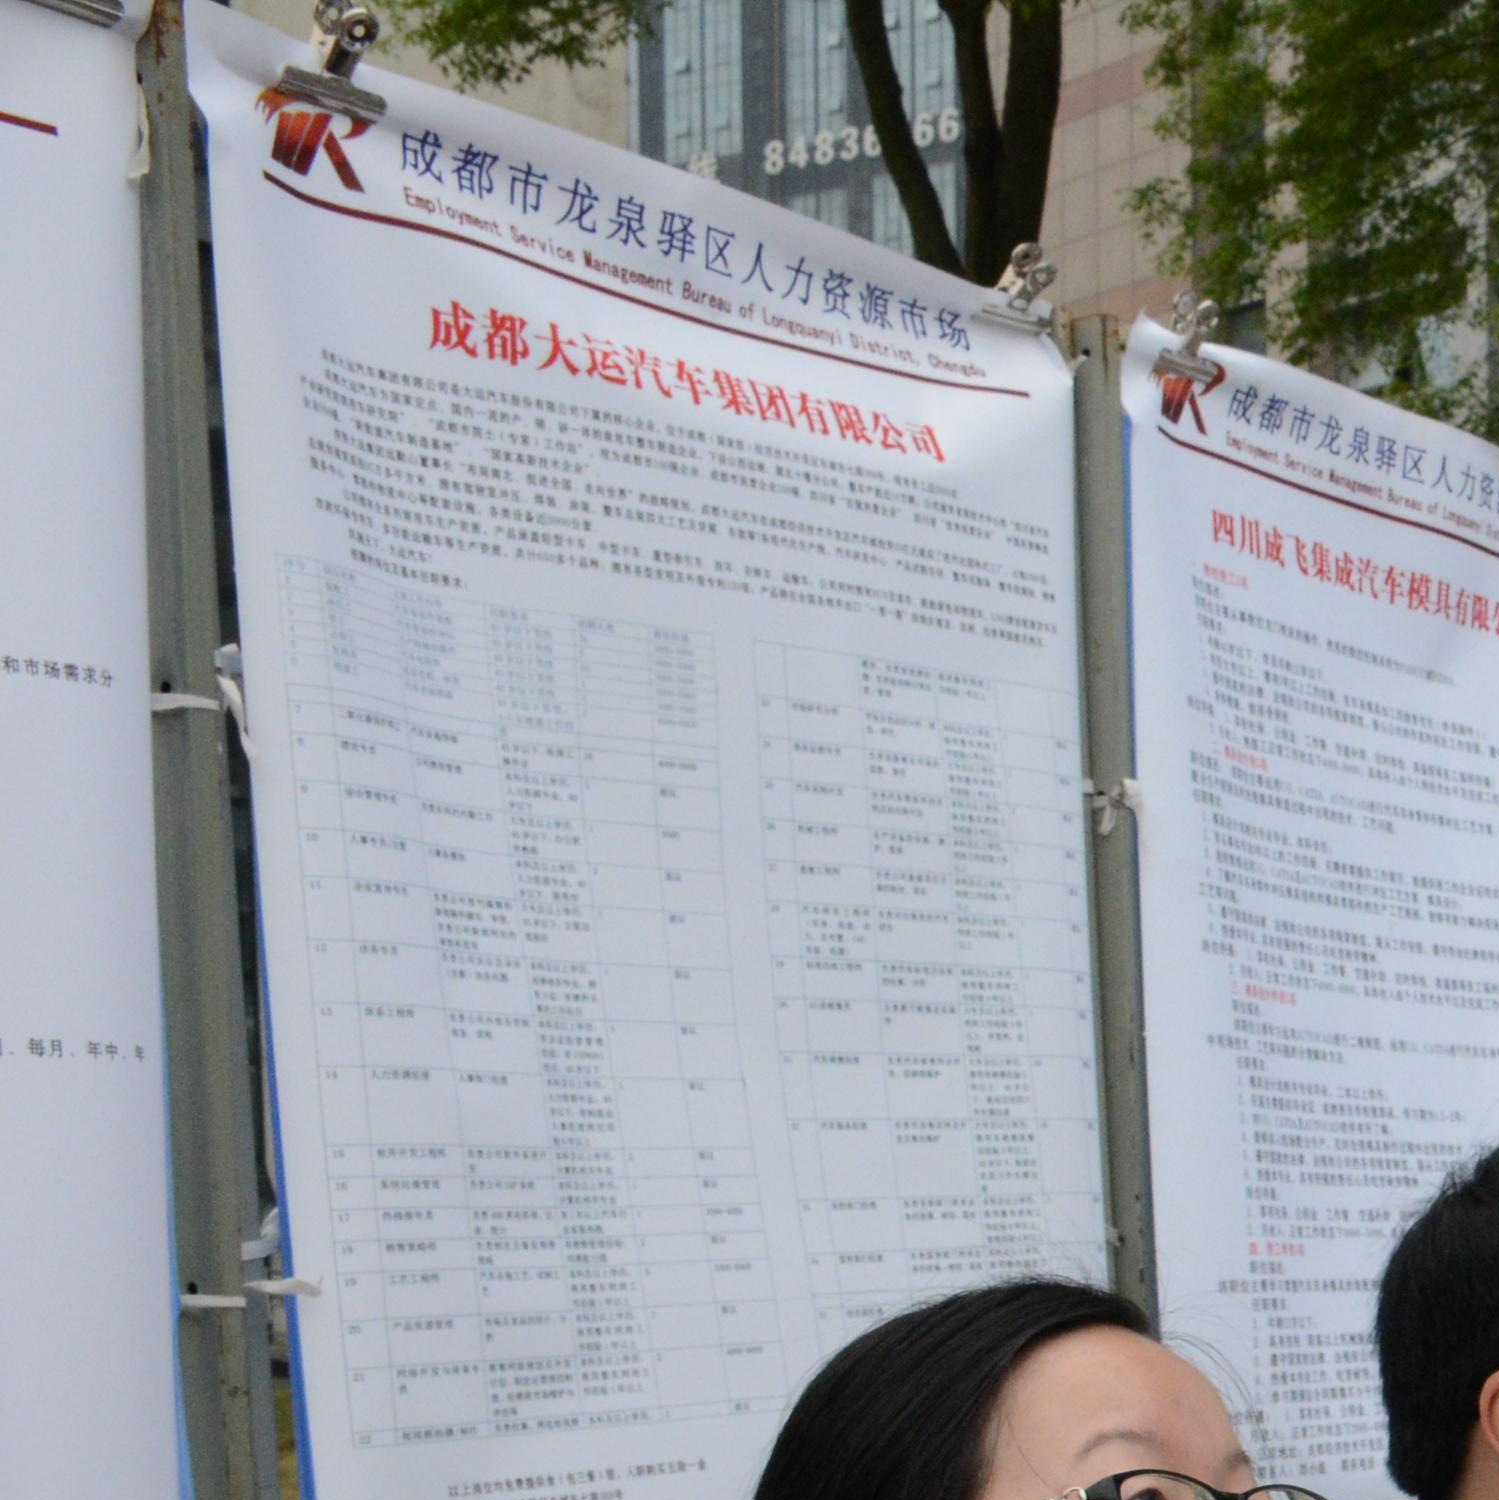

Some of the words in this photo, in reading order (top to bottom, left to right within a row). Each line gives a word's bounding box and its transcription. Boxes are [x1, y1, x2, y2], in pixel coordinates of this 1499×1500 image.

[763, 108, 960, 176] 8483666
[401, 129, 971, 352] 成都市龙泉驿区人力资源市场
[404, 186, 503, 238] Employment
[510, 224, 575, 264] Service
[582, 249, 674, 297] Management
[682, 281, 732, 315] Bureau
[739, 303, 756, 324] of
[762, 308, 844, 348] Longquanyi
[850, 331, 921, 366] District,
[928, 351, 987, 379] Chengdu
[428, 300, 946, 463] 成都大运汽车集团有限公司
